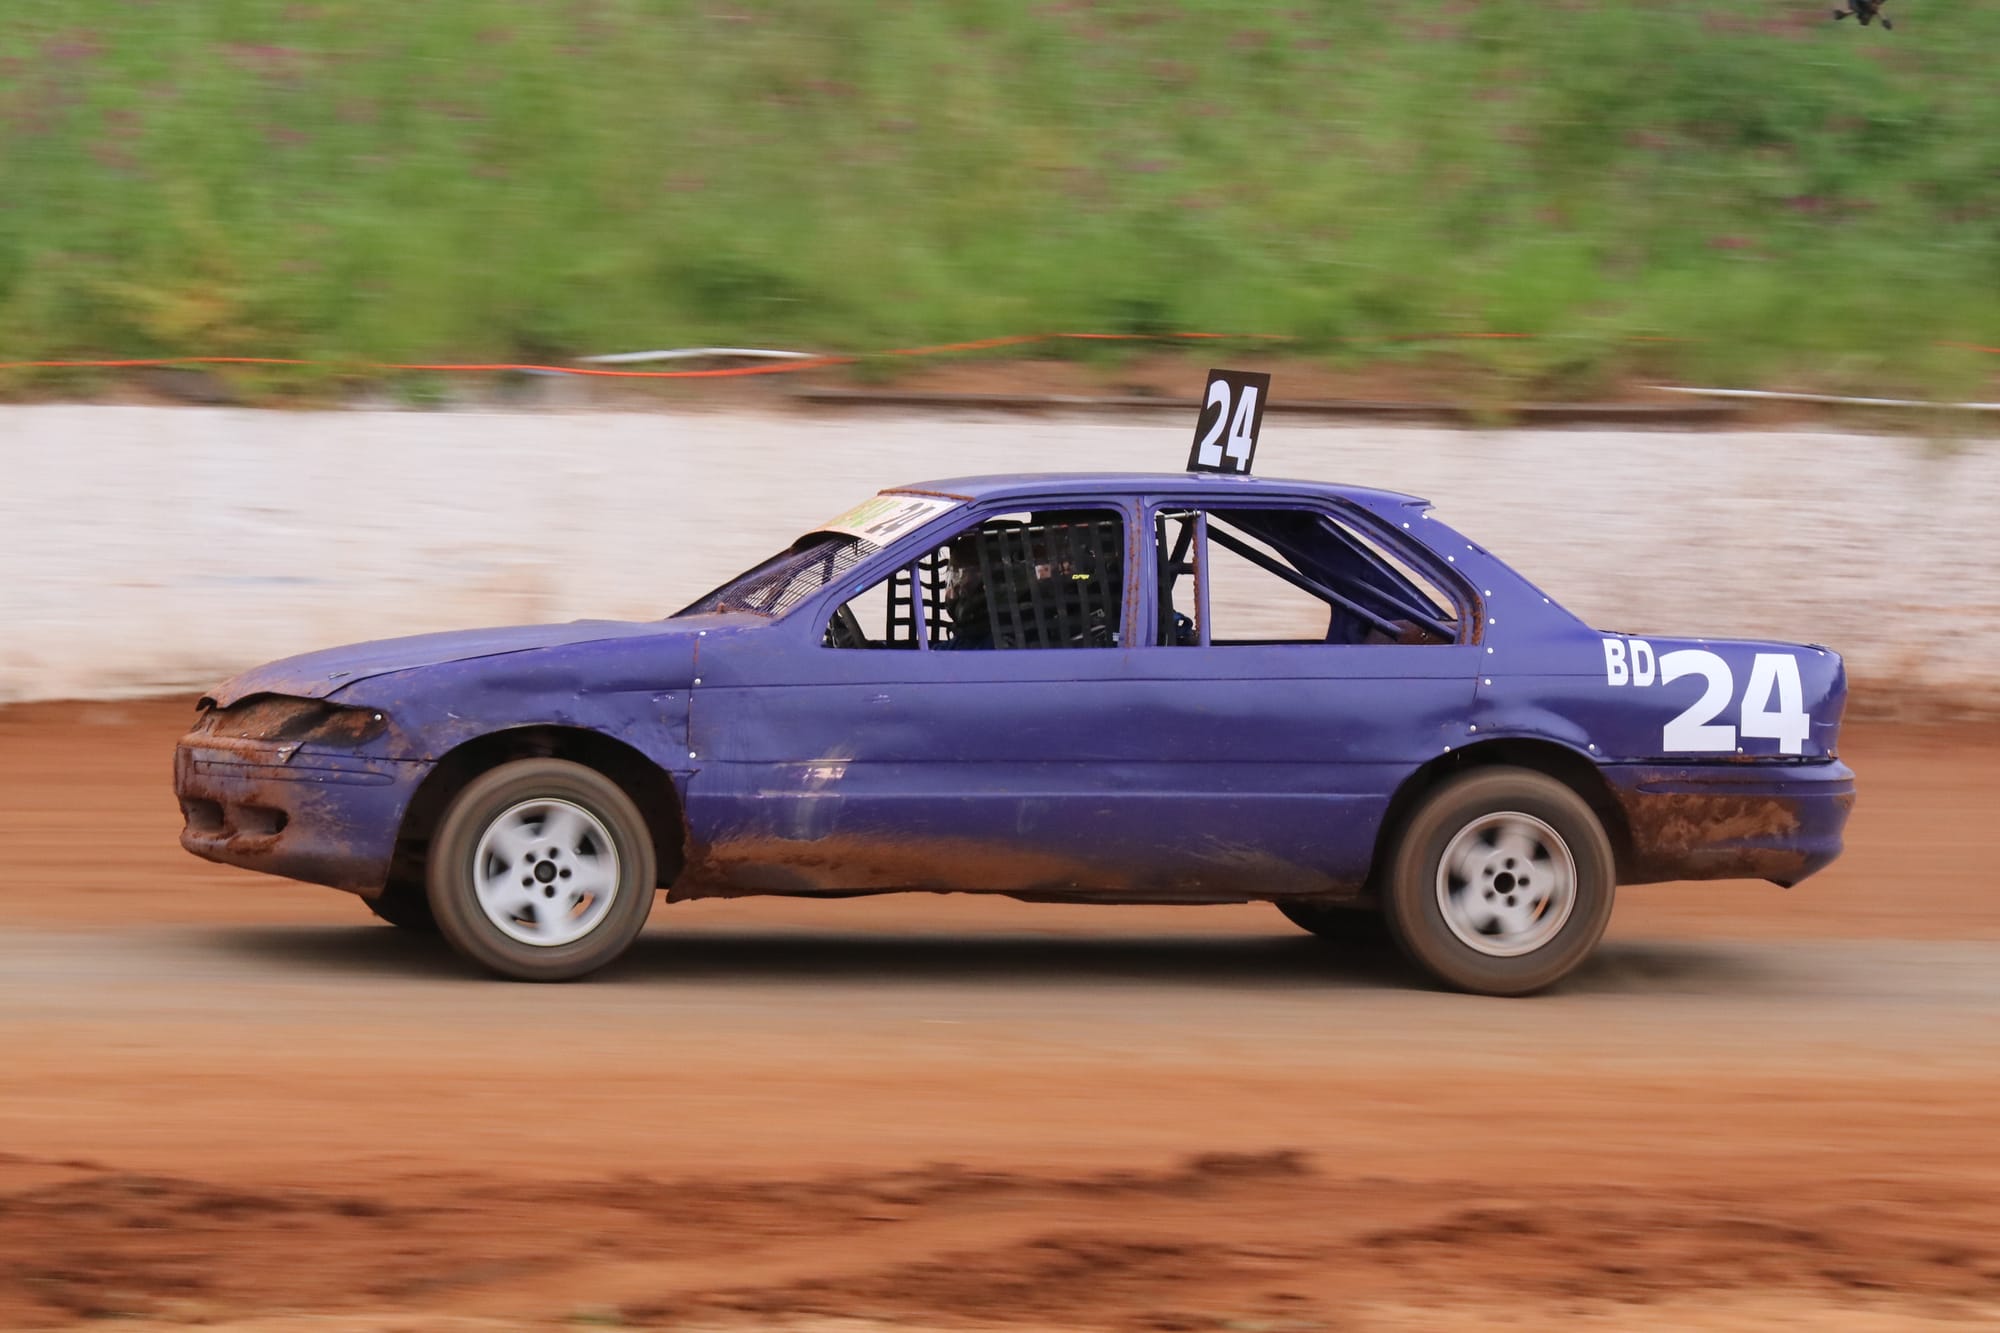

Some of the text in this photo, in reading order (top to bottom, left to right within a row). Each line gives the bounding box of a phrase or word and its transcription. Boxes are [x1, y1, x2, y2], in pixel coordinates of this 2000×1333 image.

[1198, 380, 1258, 472] 24
[864, 502, 936, 537] 24
[1602, 638, 1810, 755] BD 24
